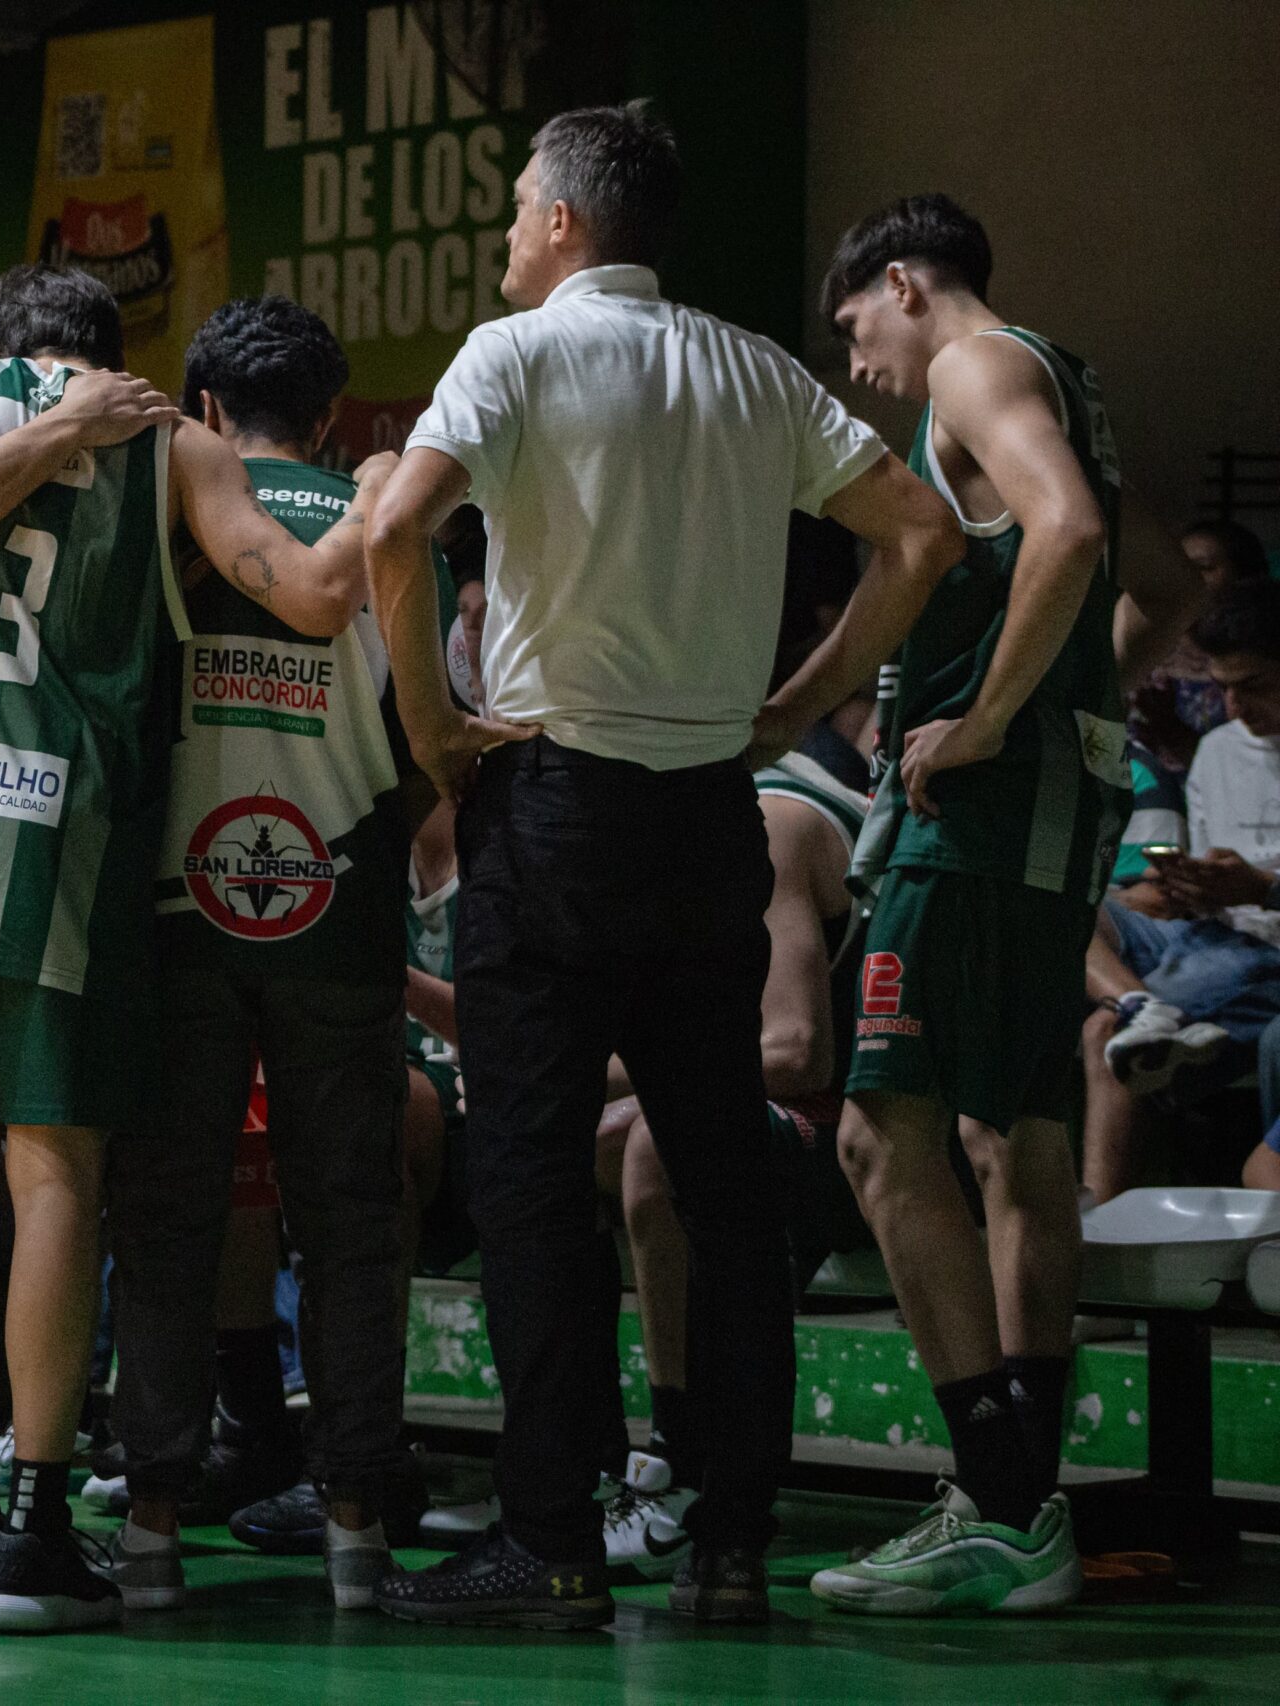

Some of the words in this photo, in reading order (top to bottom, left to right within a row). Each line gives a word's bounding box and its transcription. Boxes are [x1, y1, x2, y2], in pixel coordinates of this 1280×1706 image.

[264, 17, 344, 150] EL
[301, 143, 377, 244] DE
[390, 124, 506, 232] LOS
[270, 508, 334, 523] SEGUROS
[195, 648, 333, 686] EMBRAGUE
[193, 675, 327, 711] CONCORDIA
[0, 793, 48, 814] CALIDAD
[184, 855, 228, 875] SAN
[237, 858, 335, 879] LORENZO
